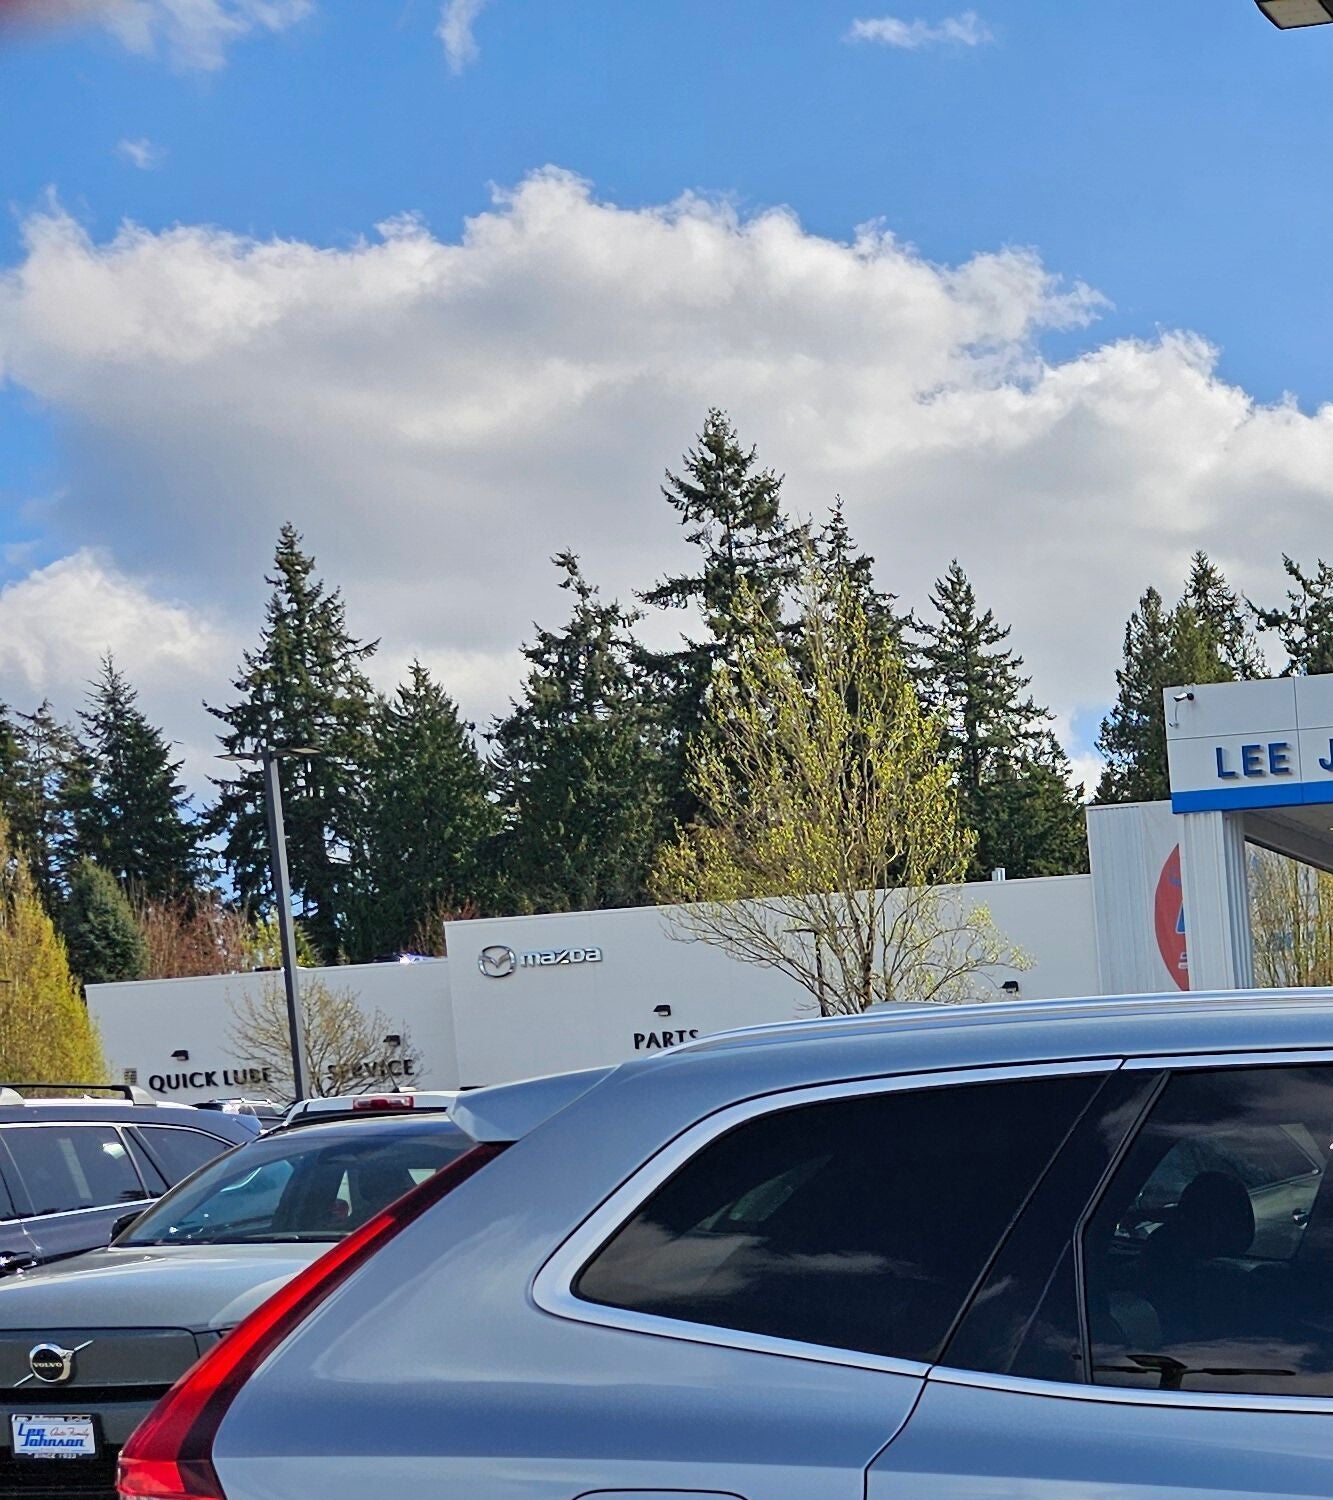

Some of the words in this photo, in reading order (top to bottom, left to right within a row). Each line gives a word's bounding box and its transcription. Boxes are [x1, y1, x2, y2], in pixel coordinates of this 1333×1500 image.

[1215, 741, 1292, 779] LEE
[148, 1071, 219, 1093] QUICK
[222, 1067, 274, 1086] LUBE
[327, 1059, 415, 1080] SRVICE
[18, 1423, 46, 1437] Lee
[20, 1429, 85, 1447] Johnson
